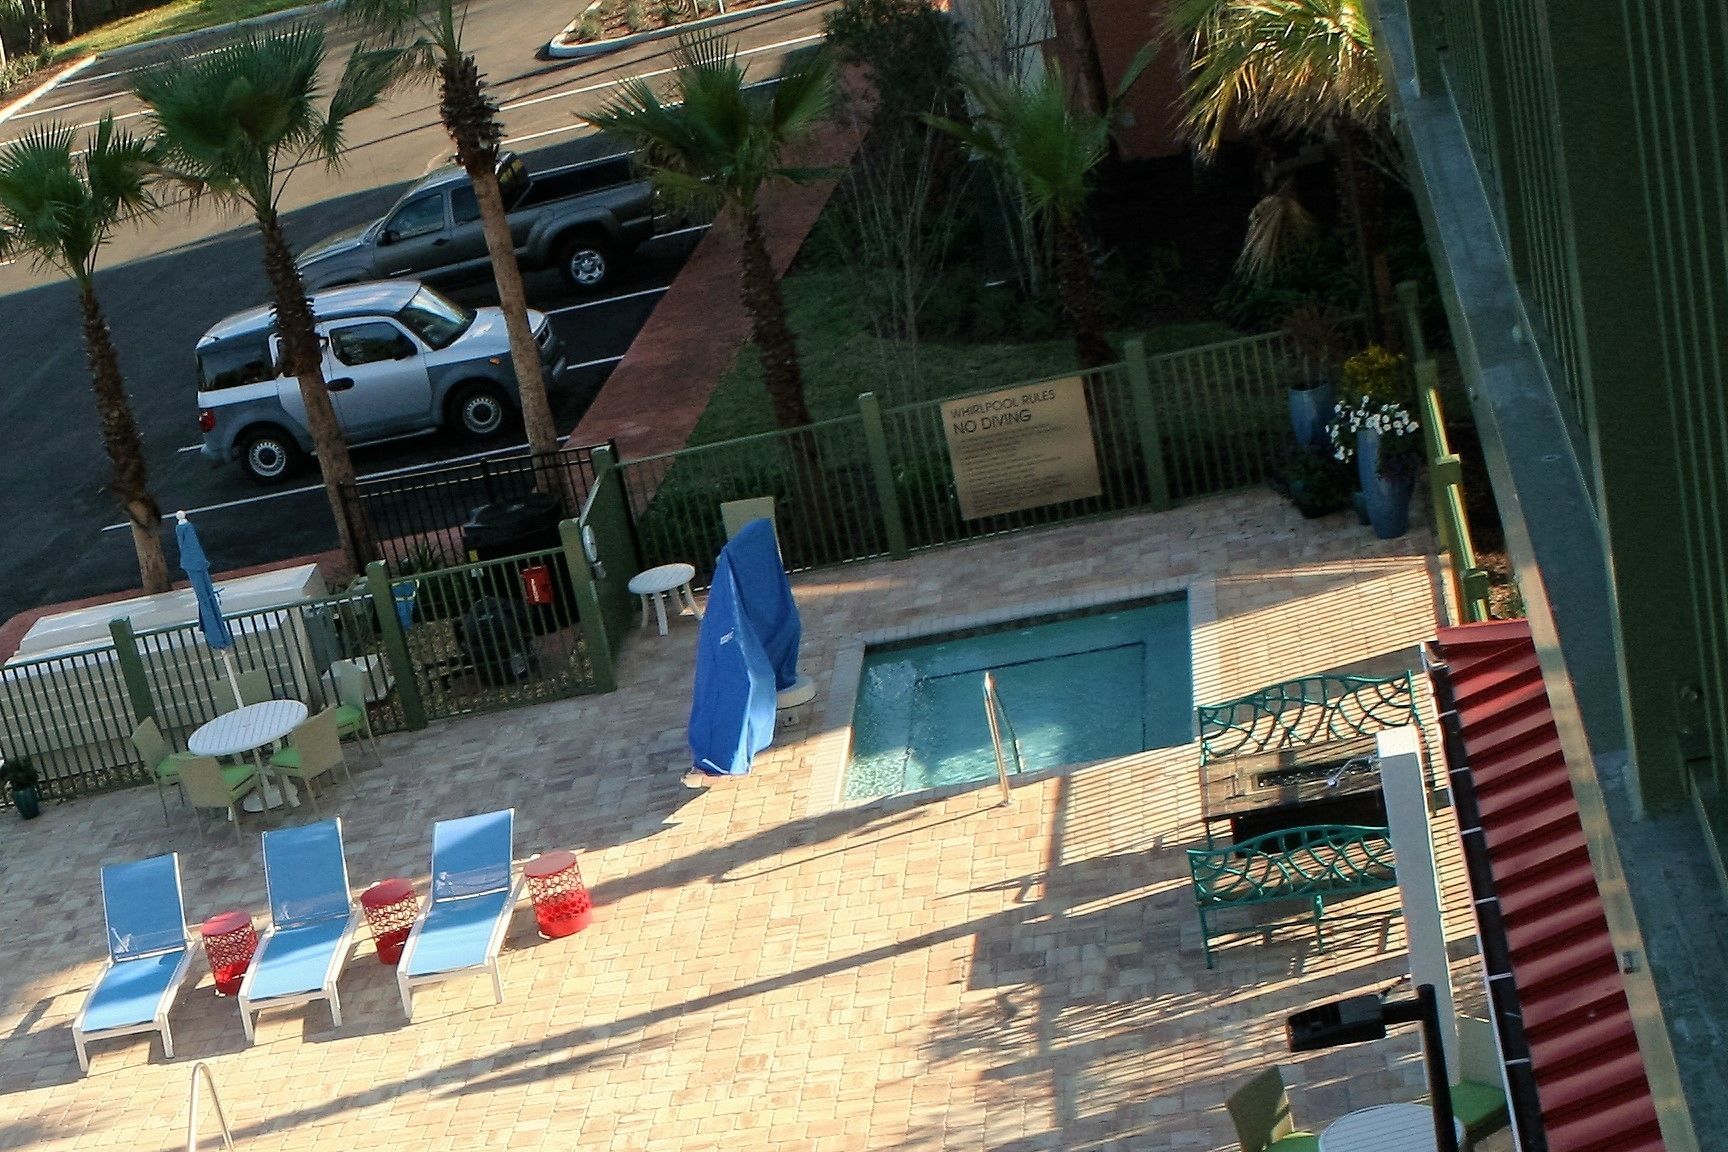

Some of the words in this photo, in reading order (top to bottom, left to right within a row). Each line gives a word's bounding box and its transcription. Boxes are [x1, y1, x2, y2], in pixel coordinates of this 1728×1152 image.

[950, 398, 1020, 418] WHIRLPOOL
[1022, 389, 1057, 405] RULES
[953, 420, 977, 435] NO
[981, 408, 1033, 431] DIVING
